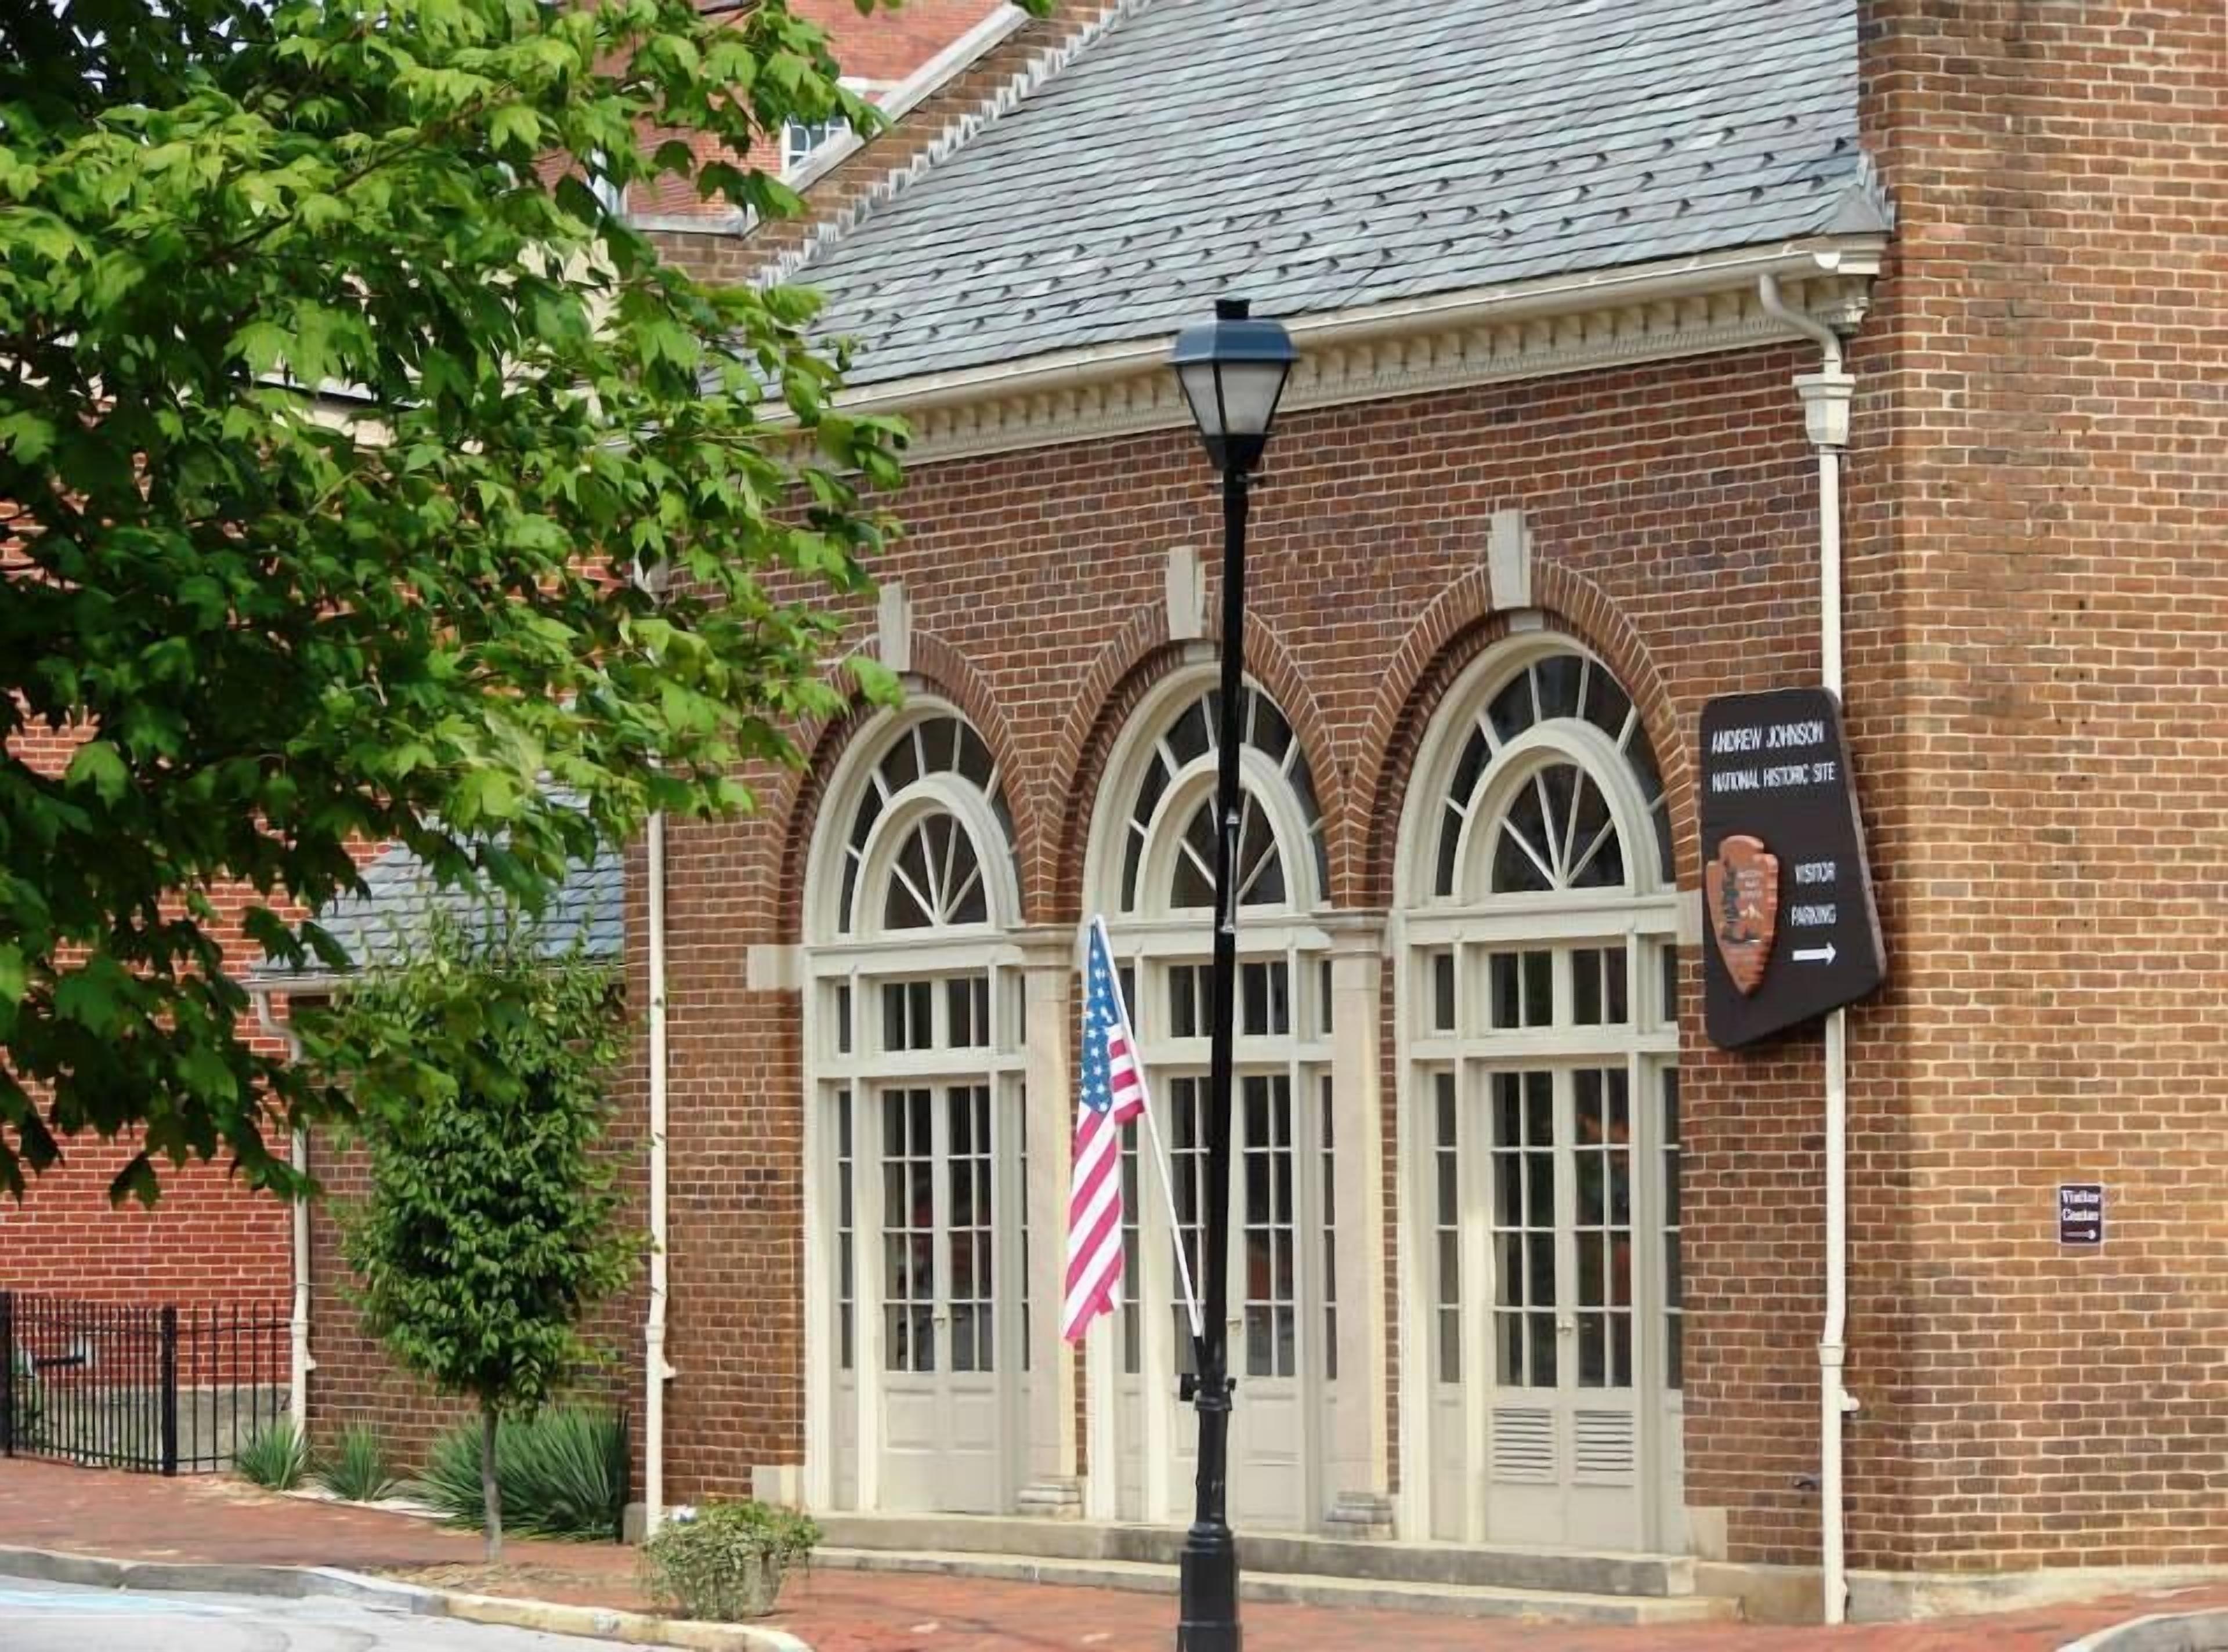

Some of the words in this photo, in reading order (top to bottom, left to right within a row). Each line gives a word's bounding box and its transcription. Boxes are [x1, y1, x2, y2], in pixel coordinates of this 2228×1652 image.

[1712, 727, 1762, 753] ANDREW
[1766, 721, 1824, 748] JOHNSON
[1712, 768, 1759, 792] NATIONAL
[1763, 763, 1809, 787] HISTORIC
[1813, 760, 1836, 782] SITE
[1795, 861, 1835, 883] VISITOR
[1791, 904, 1836, 926] PARKING
